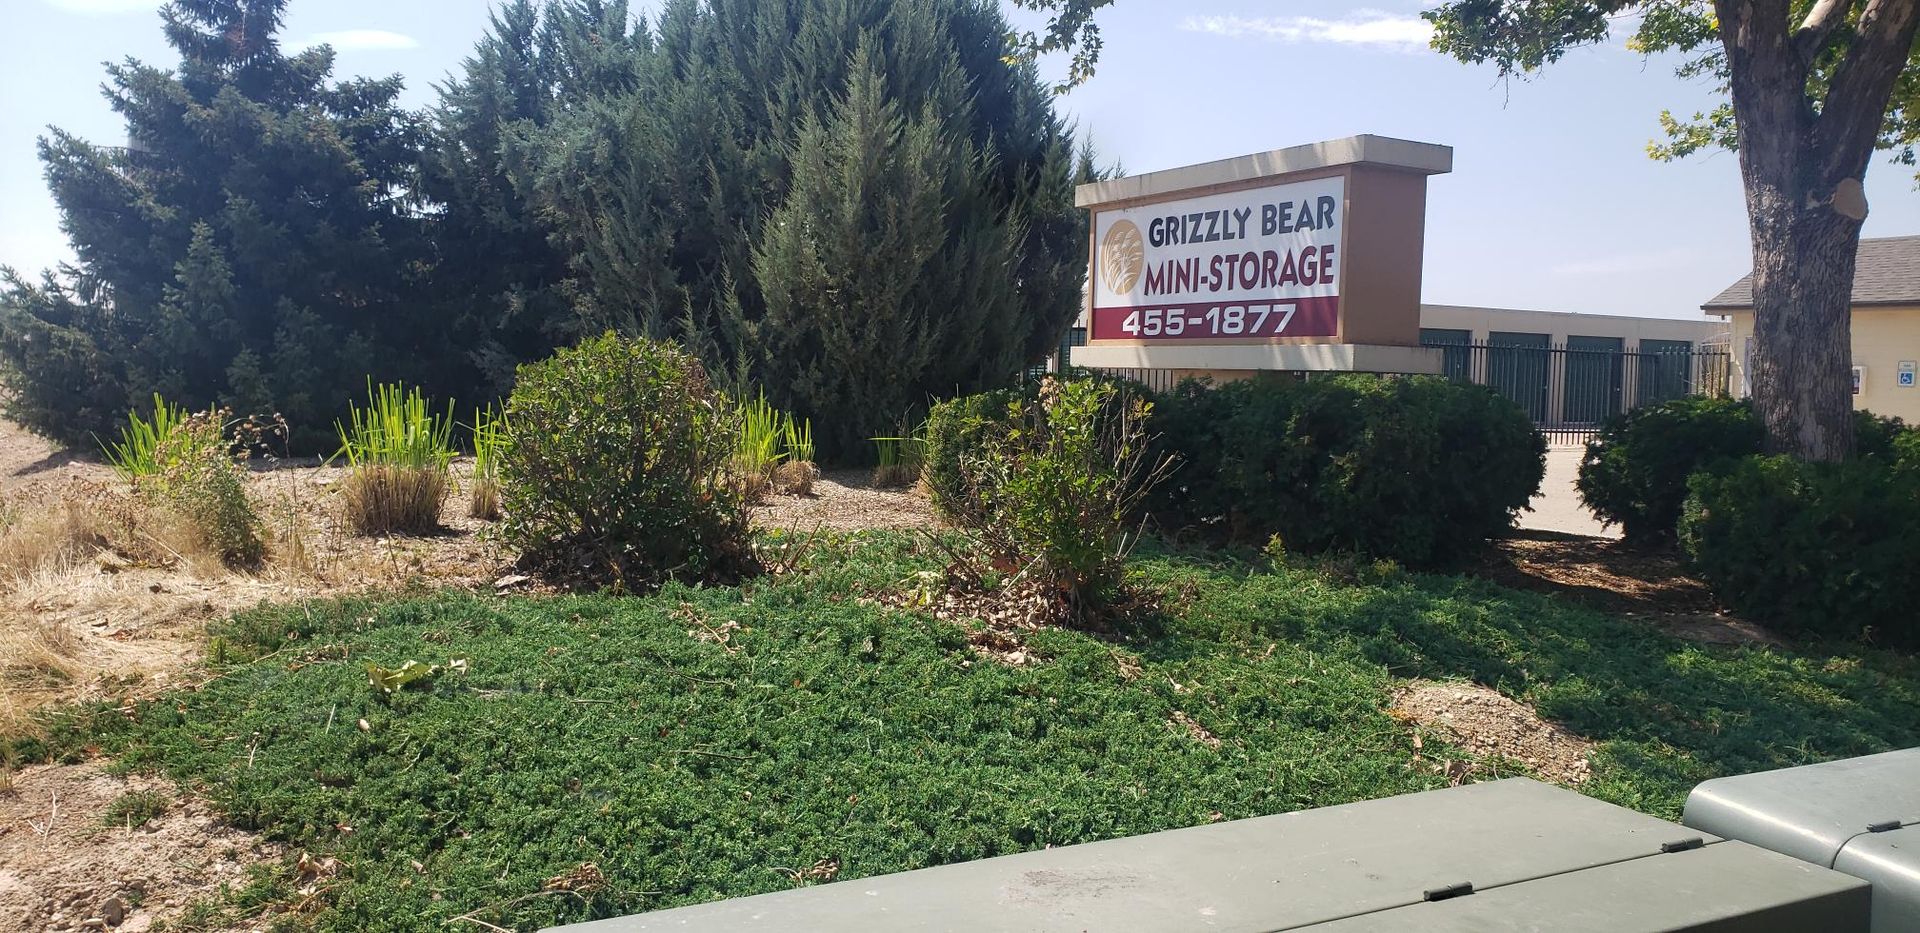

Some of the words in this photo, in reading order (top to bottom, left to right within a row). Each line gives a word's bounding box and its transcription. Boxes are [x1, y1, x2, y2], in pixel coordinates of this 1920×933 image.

[1149, 206, 1252, 248] GRIZZLY
[1261, 195, 1335, 237] BEAR
[1144, 244, 1335, 296] MINI-STORAGE
[1122, 304, 1297, 336] 455-1877
